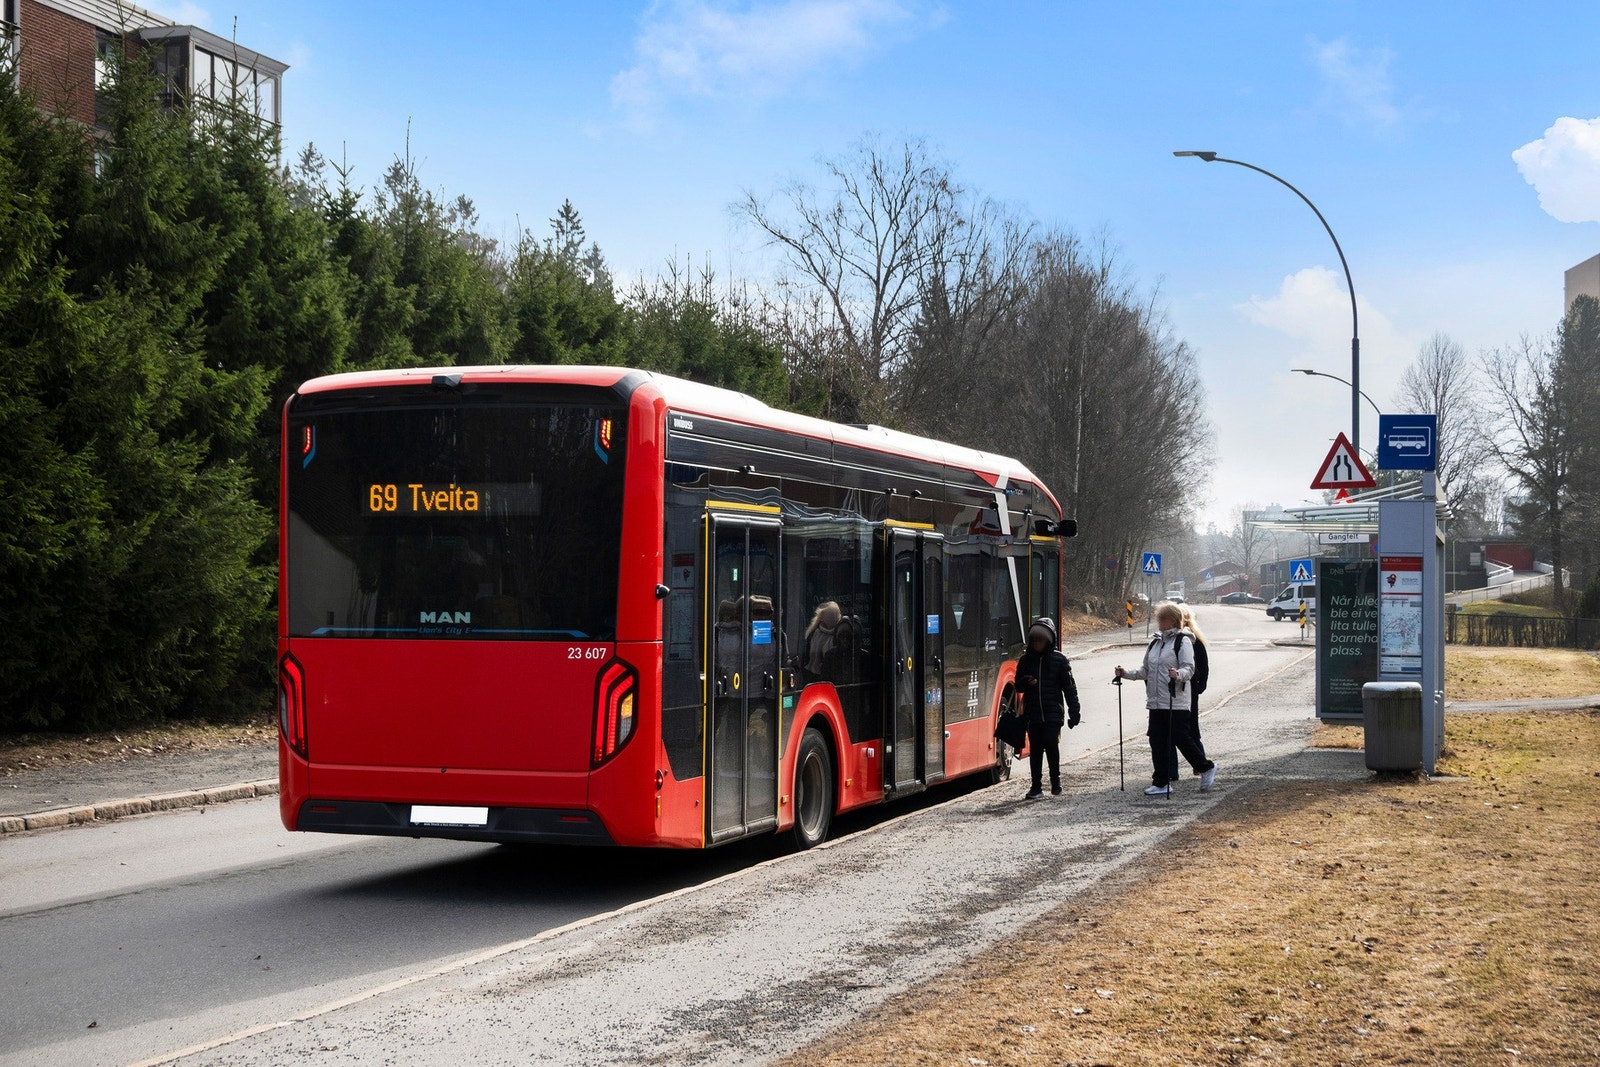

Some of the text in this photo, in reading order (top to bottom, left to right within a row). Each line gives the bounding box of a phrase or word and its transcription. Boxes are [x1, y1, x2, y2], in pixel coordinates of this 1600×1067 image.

[369, 483, 479, 511] 69 Tveita
[1330, 595, 1352, 606] Når
[420, 611, 471, 624] MAN
[1330, 608, 1349, 618] ble
[1351, 608, 1362, 618] ei
[1330, 620, 1349, 630] lita
[568, 647, 607, 659] 23 607
[1330, 645, 1363, 657] plass.
